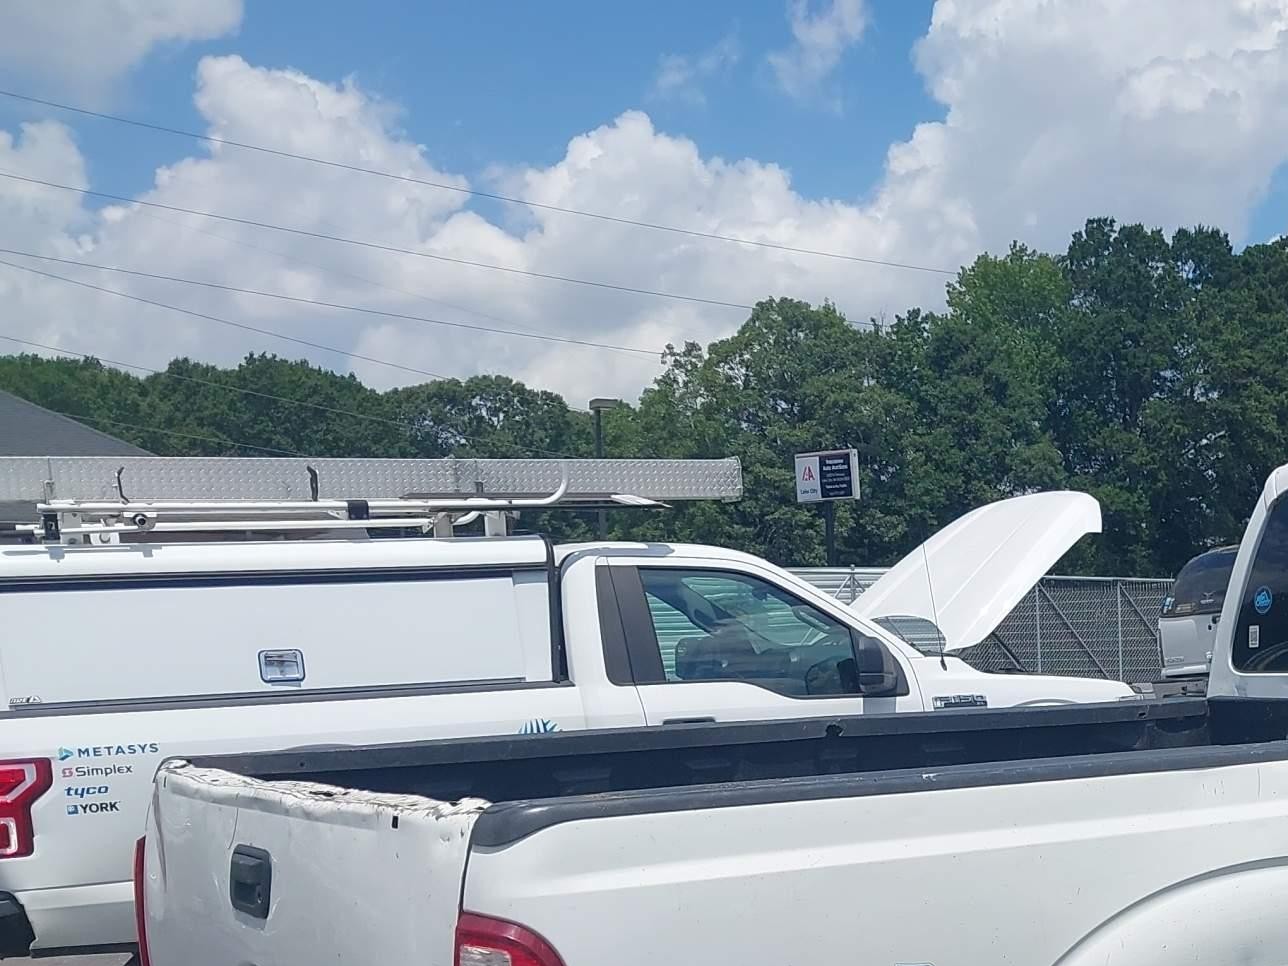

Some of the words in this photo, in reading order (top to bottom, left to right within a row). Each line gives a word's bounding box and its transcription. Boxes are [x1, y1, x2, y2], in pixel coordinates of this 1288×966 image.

[77, 743, 160, 758] METASYS
[75, 764, 133, 777] Simplex
[65, 785, 109, 798] tyco
[80, 800, 120, 814] YORK
